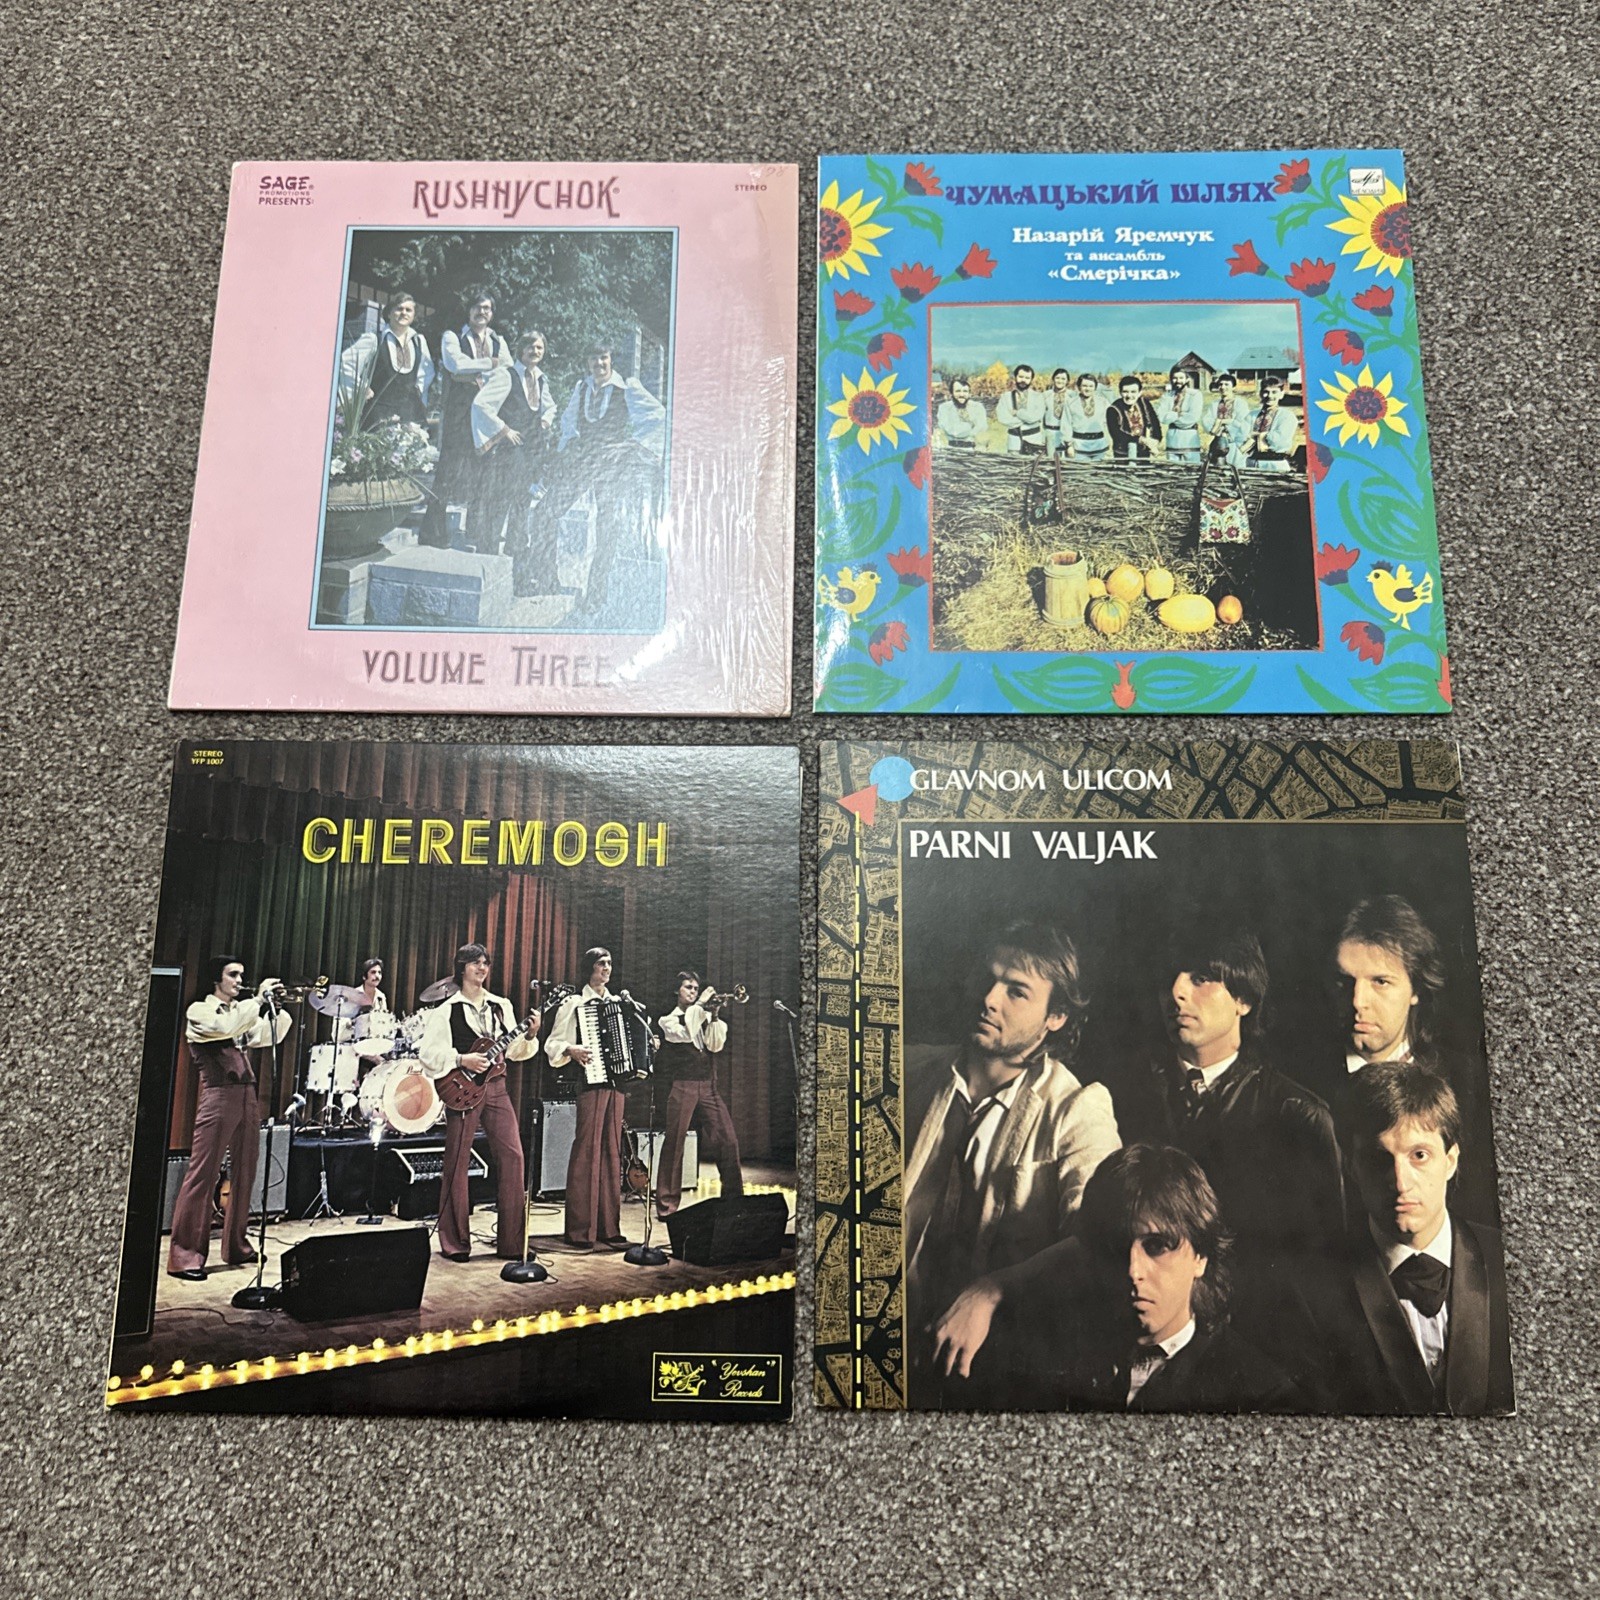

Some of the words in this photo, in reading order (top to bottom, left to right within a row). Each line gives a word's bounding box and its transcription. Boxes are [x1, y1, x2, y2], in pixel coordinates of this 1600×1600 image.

[946, 179, 1158, 210] ЧУМАЦЬКИЙ
[1171, 182, 1276, 203] ШЛЯХ
[1012, 227, 1104, 244] Назарій
[1115, 226, 1215, 244] Яремчук
[1065, 252, 1083, 261] та
[1089, 251, 1166, 262] ансамбль
[1047, 265, 1181, 284] «Смерічка»
[362, 650, 486, 685] VOLUME
[512, 646, 613, 687] THREE
[909, 769, 1046, 791] GLAVNOM
[1063, 769, 1173, 791] ULICOM
[302, 817, 669, 868] CHEREMOSH
[909, 829, 1011, 859] PARNI
[1032, 830, 1158, 865] VALJAK
